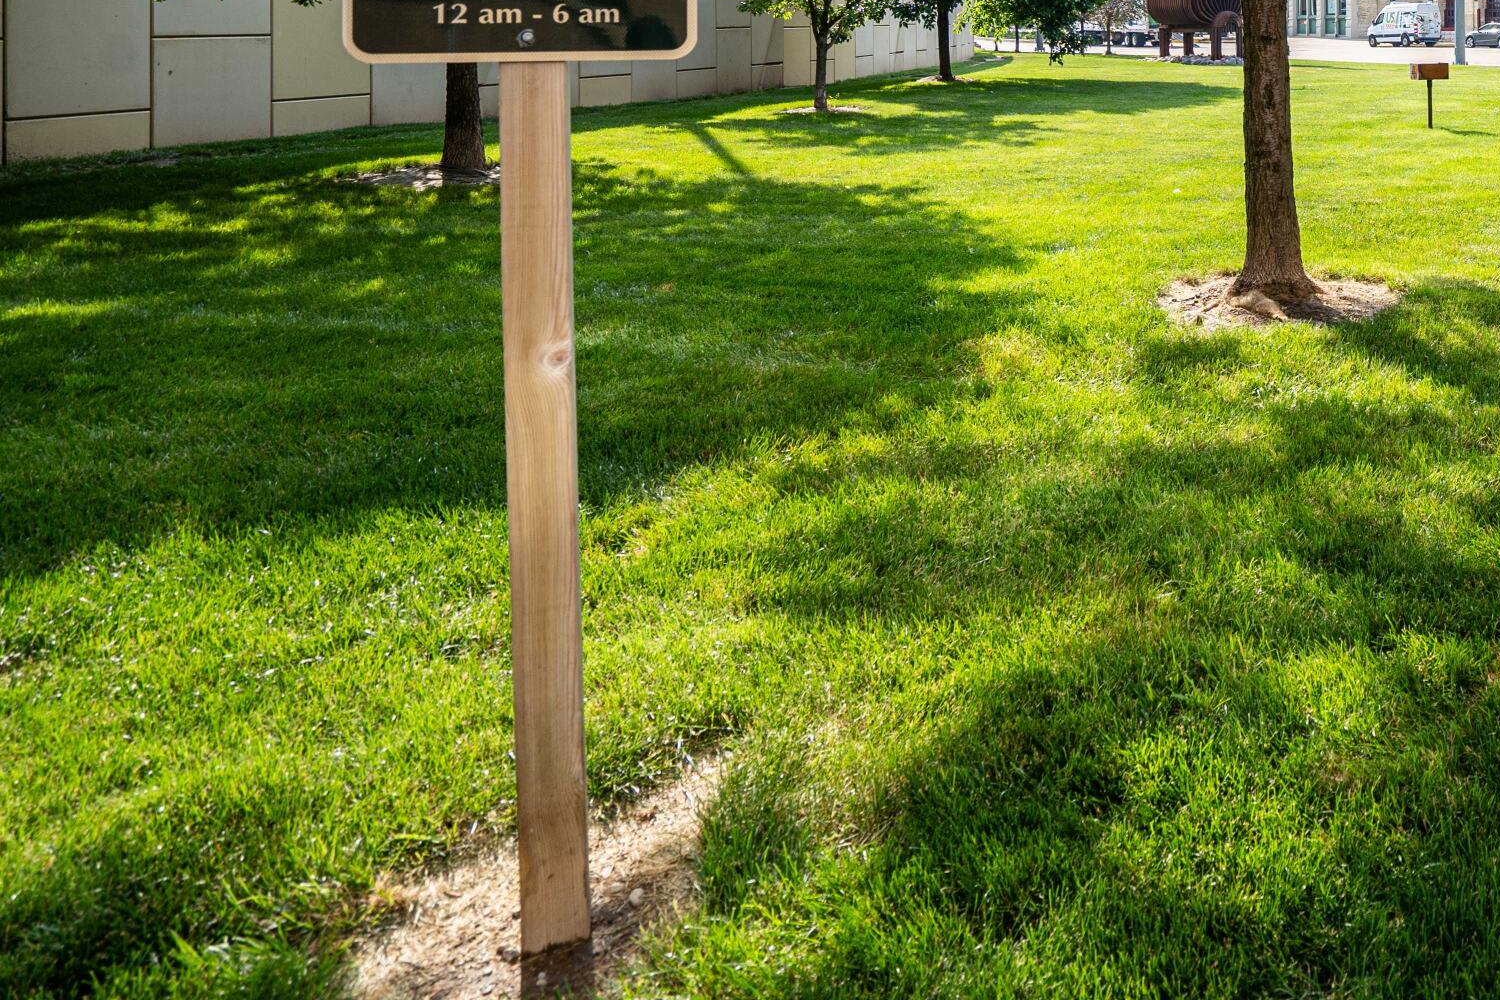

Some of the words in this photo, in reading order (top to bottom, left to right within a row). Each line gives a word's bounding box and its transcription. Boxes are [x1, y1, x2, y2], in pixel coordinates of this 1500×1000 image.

[432, 3, 468, 24] 12
[478, 8, 522, 25] am
[552, 3, 570, 24] 6
[578, 8, 620, 24] am
